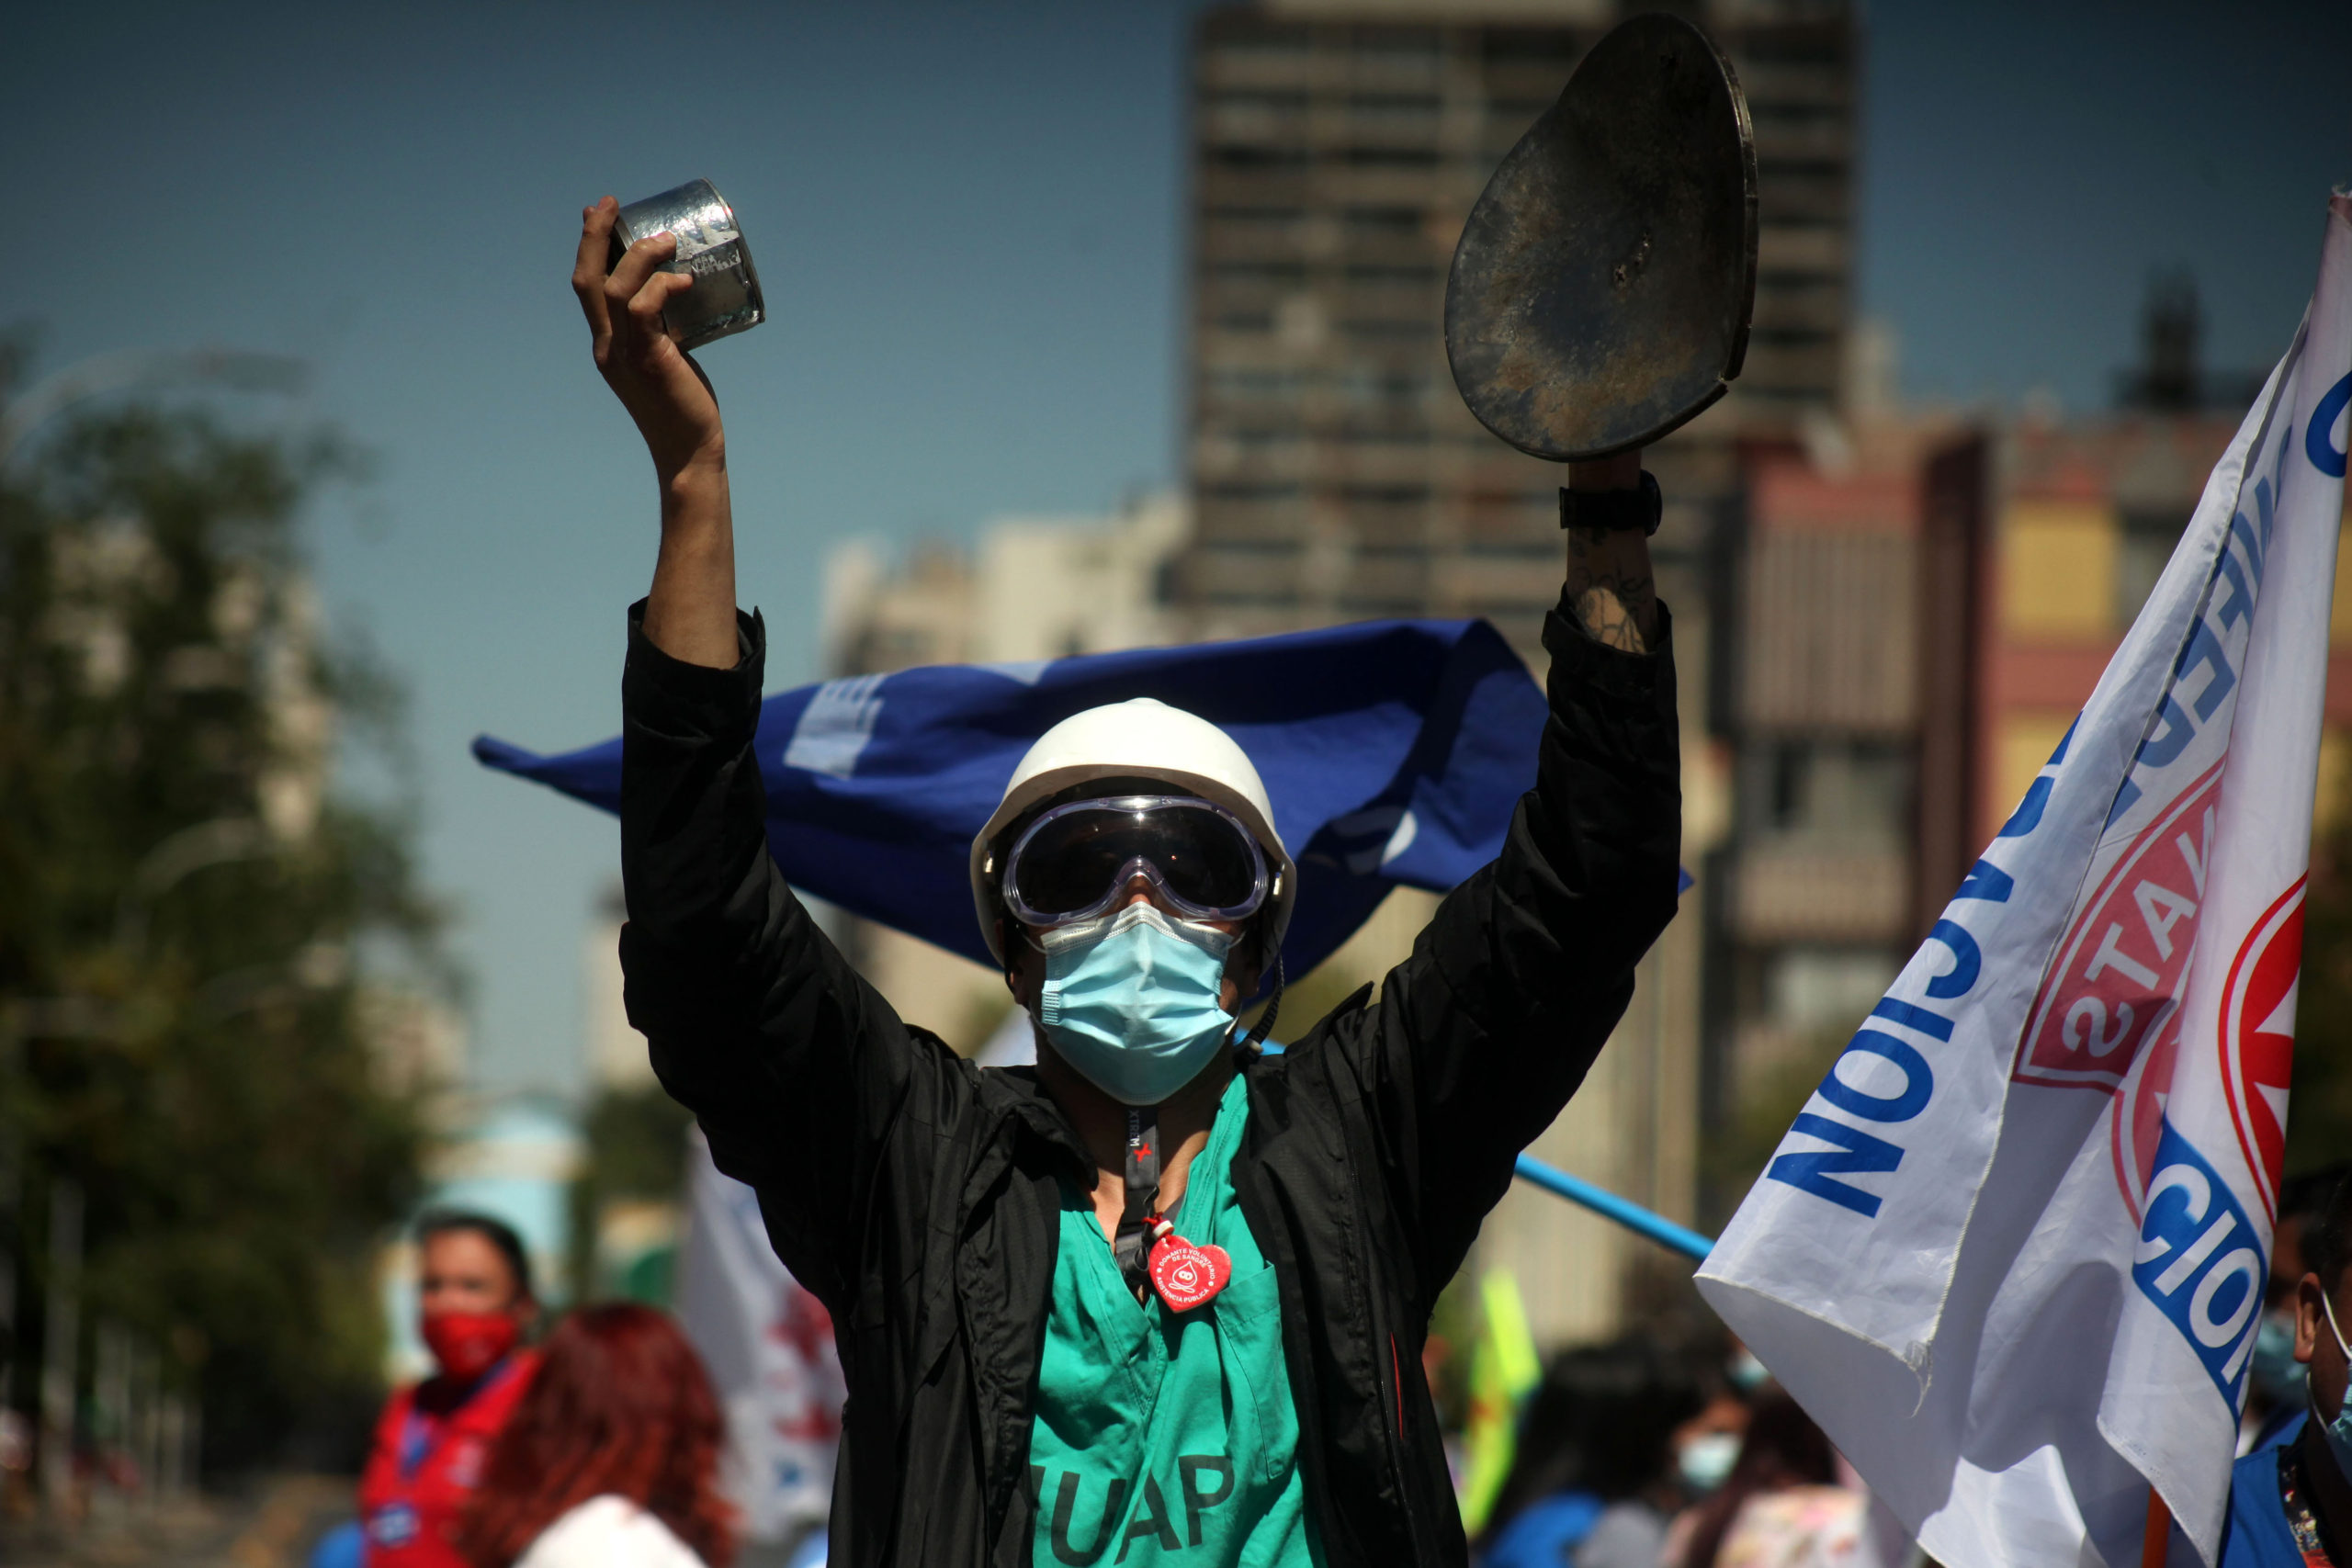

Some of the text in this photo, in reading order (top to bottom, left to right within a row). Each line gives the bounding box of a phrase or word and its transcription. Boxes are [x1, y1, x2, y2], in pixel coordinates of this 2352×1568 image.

[1159, 1248, 1216, 1280] DONANTE VOLUNTARIO
[1182, 1254, 1207, 1268] SANGRE
[1030, 1454, 1236, 1568] UAP
